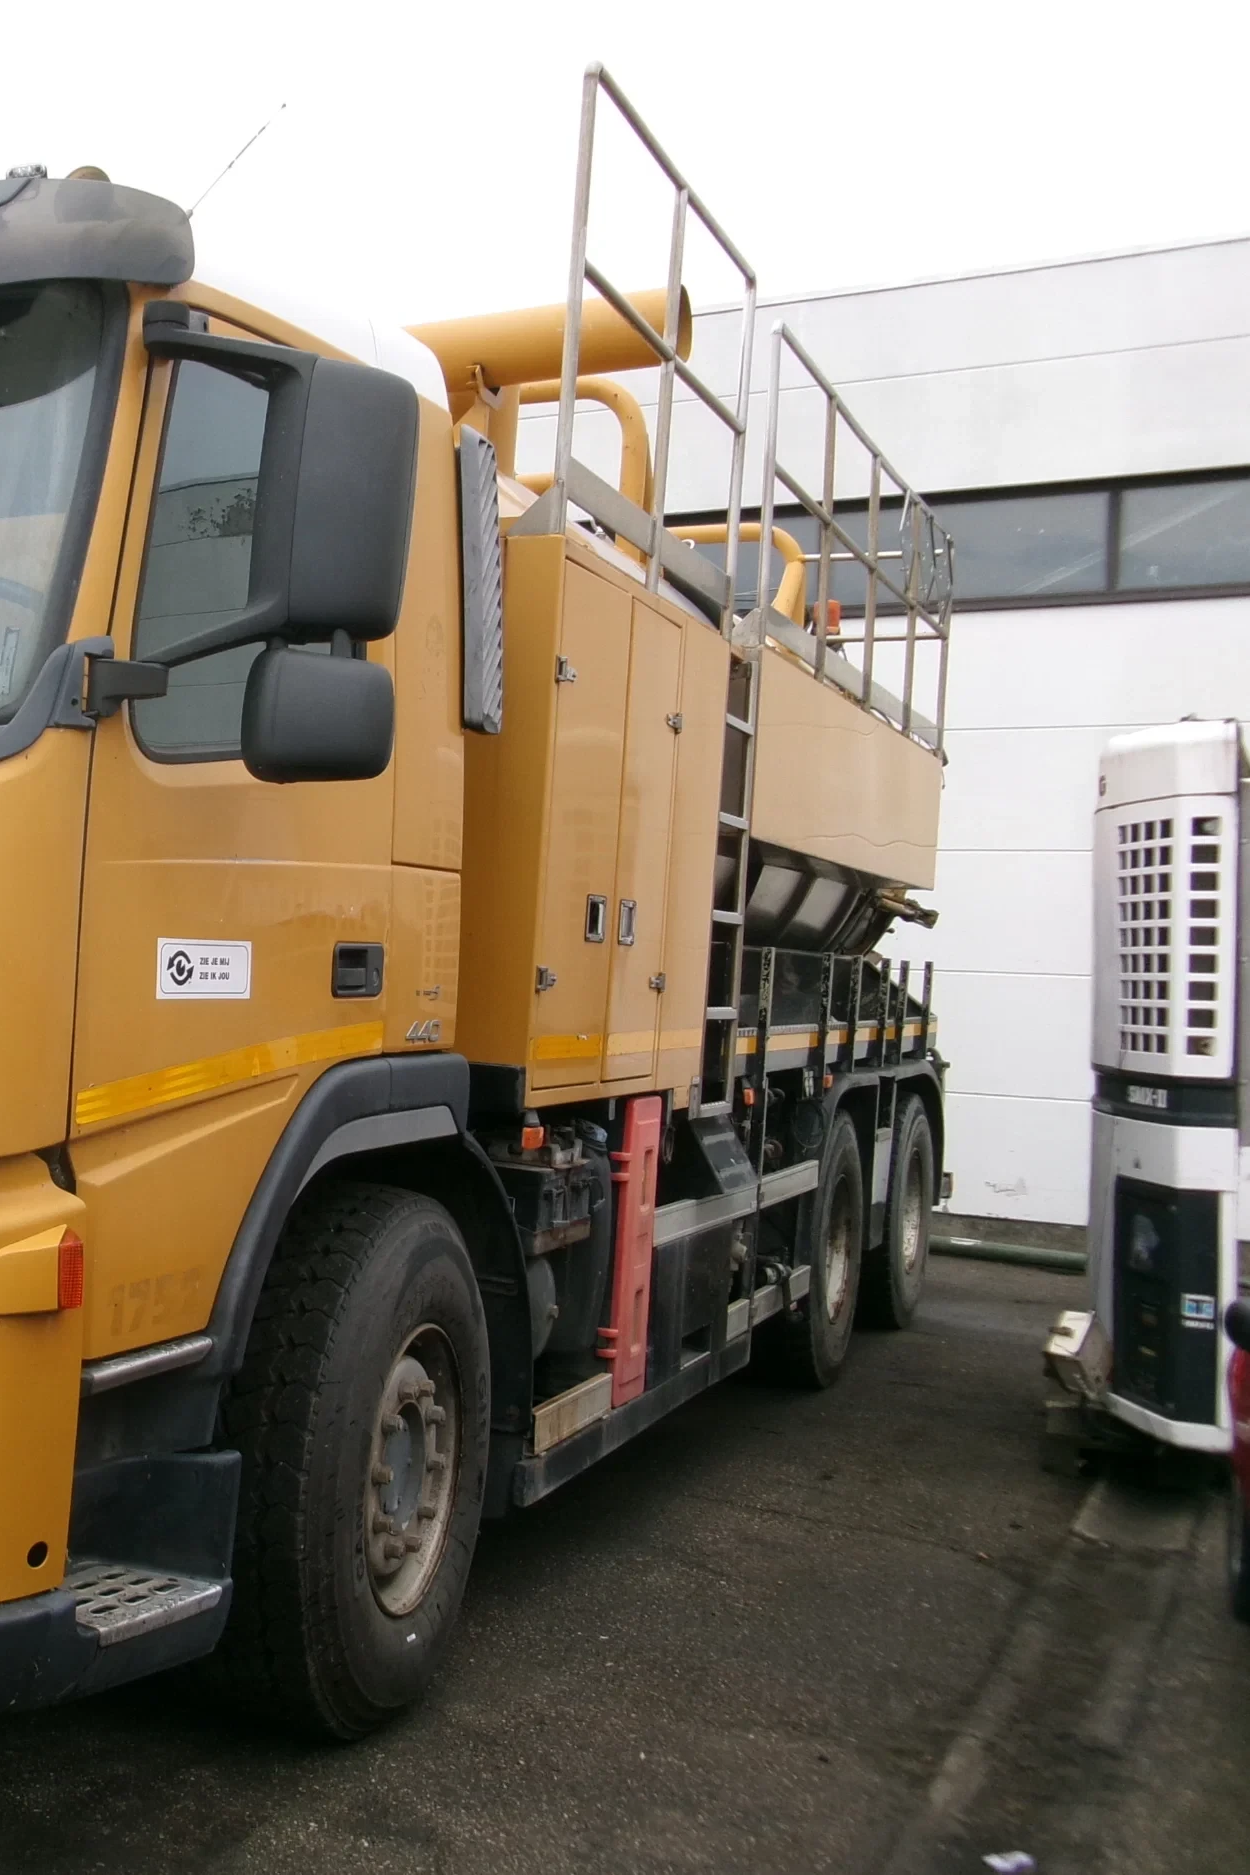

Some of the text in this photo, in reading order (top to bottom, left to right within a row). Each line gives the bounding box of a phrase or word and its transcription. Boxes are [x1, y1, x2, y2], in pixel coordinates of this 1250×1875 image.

[199, 957, 230, 966] ZIE JE MIJ
[199, 971, 230, 980] ZIE IK JOU
